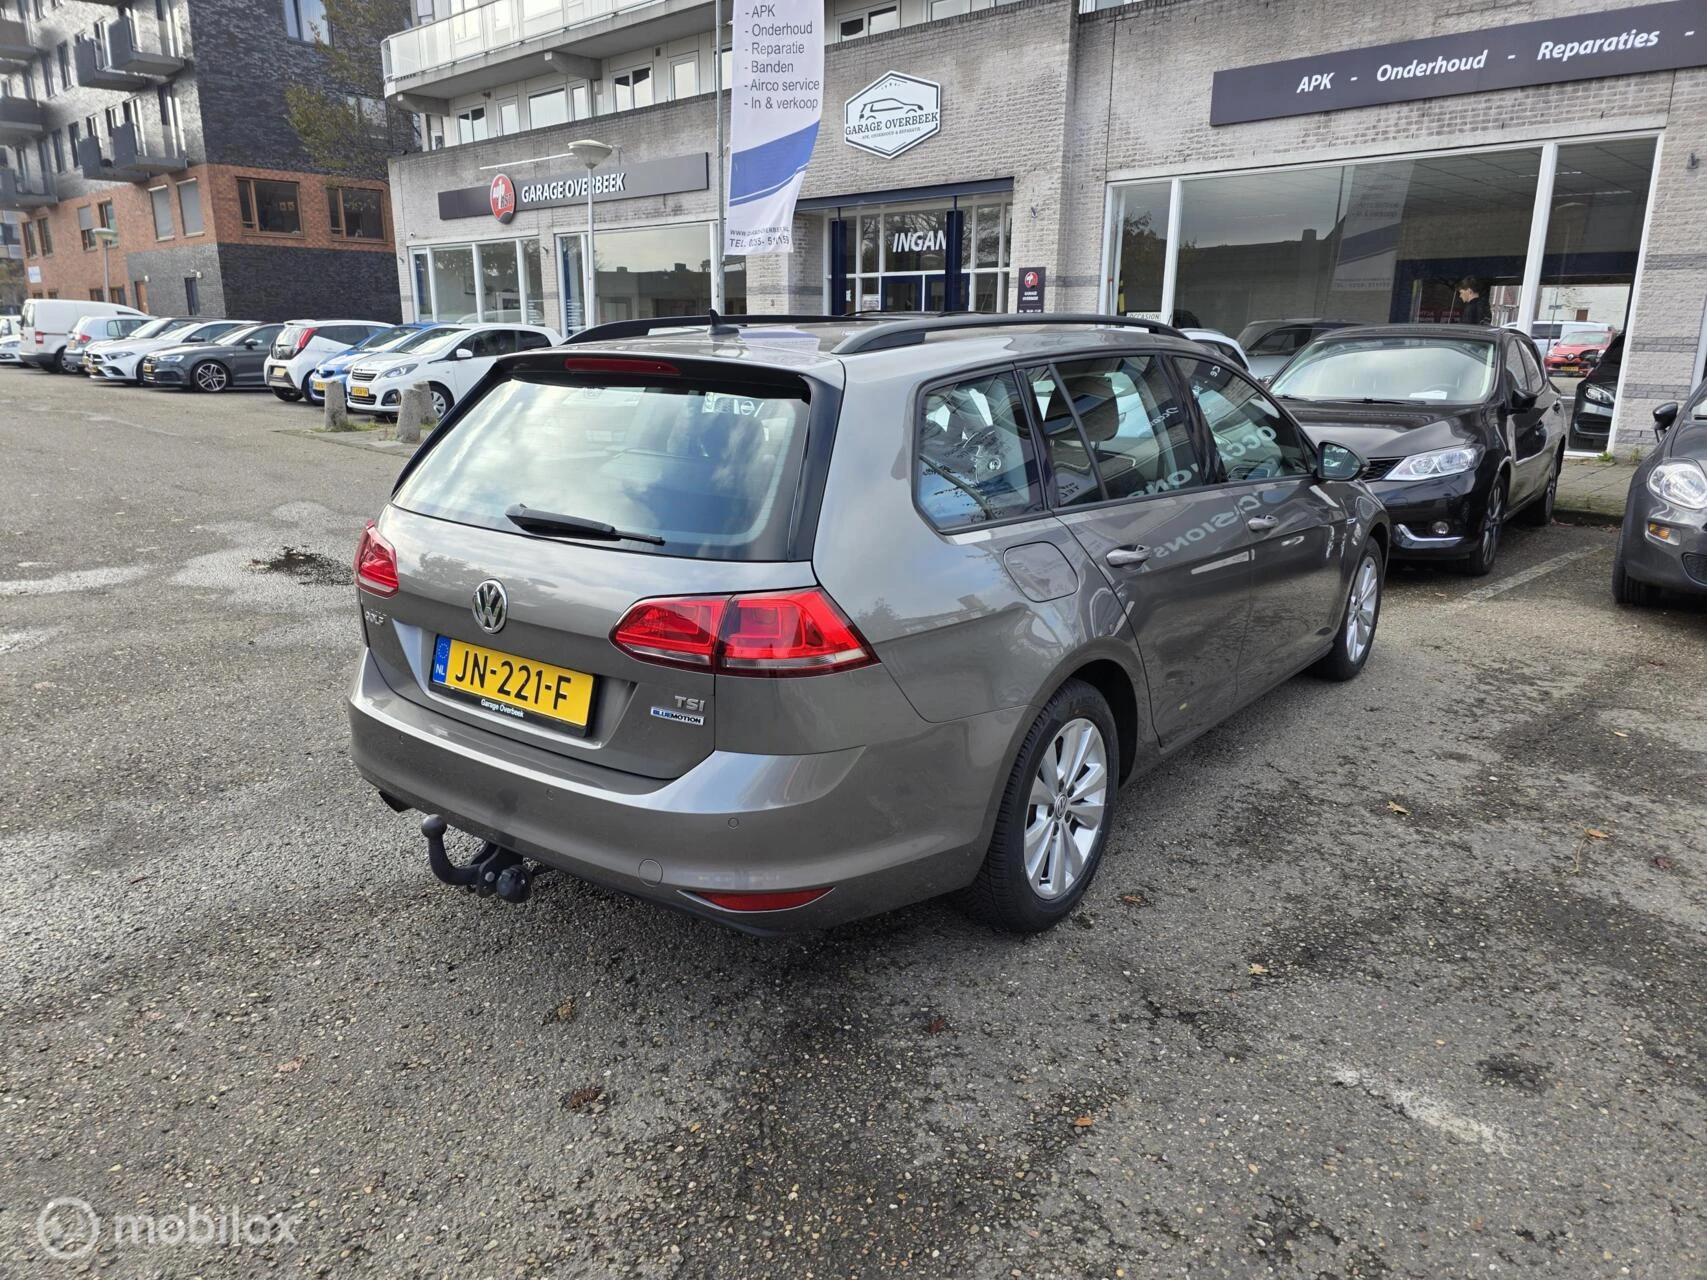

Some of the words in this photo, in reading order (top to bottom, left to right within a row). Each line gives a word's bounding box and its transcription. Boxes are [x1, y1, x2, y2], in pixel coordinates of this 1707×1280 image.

[751, 4, 775, 18] APK
[751, 20, 813, 37] Onderhoud
[751, 41, 805, 58] Reparatie
[751, 60, 794, 73] Banden
[1296, 72, 1335, 94] APK
[1376, 49, 1488, 82] Onderhoud
[1537, 29, 1660, 62] Reparaties
[750, 78, 779, 92] Airco
[781, 77, 820, 92] service
[751, 97, 761, 110] In
[765, 97, 773, 110] &
[776, 97, 819, 112] verkoop
[845, 121, 883, 136] GARAGE
[885, 112, 939, 129] OVERBEEK
[521, 181, 563, 203] GARAGE
[892, 230, 947, 253] INGAN
[435, 664, 446, 676] NL
[455, 650, 572, 710] JN-221-F
[480, 698, 500, 712] Garage
[499, 703, 525, 718] Overbeek
[674, 695, 705, 712] TSI
[652, 709, 701, 724] BLUEMOTION
